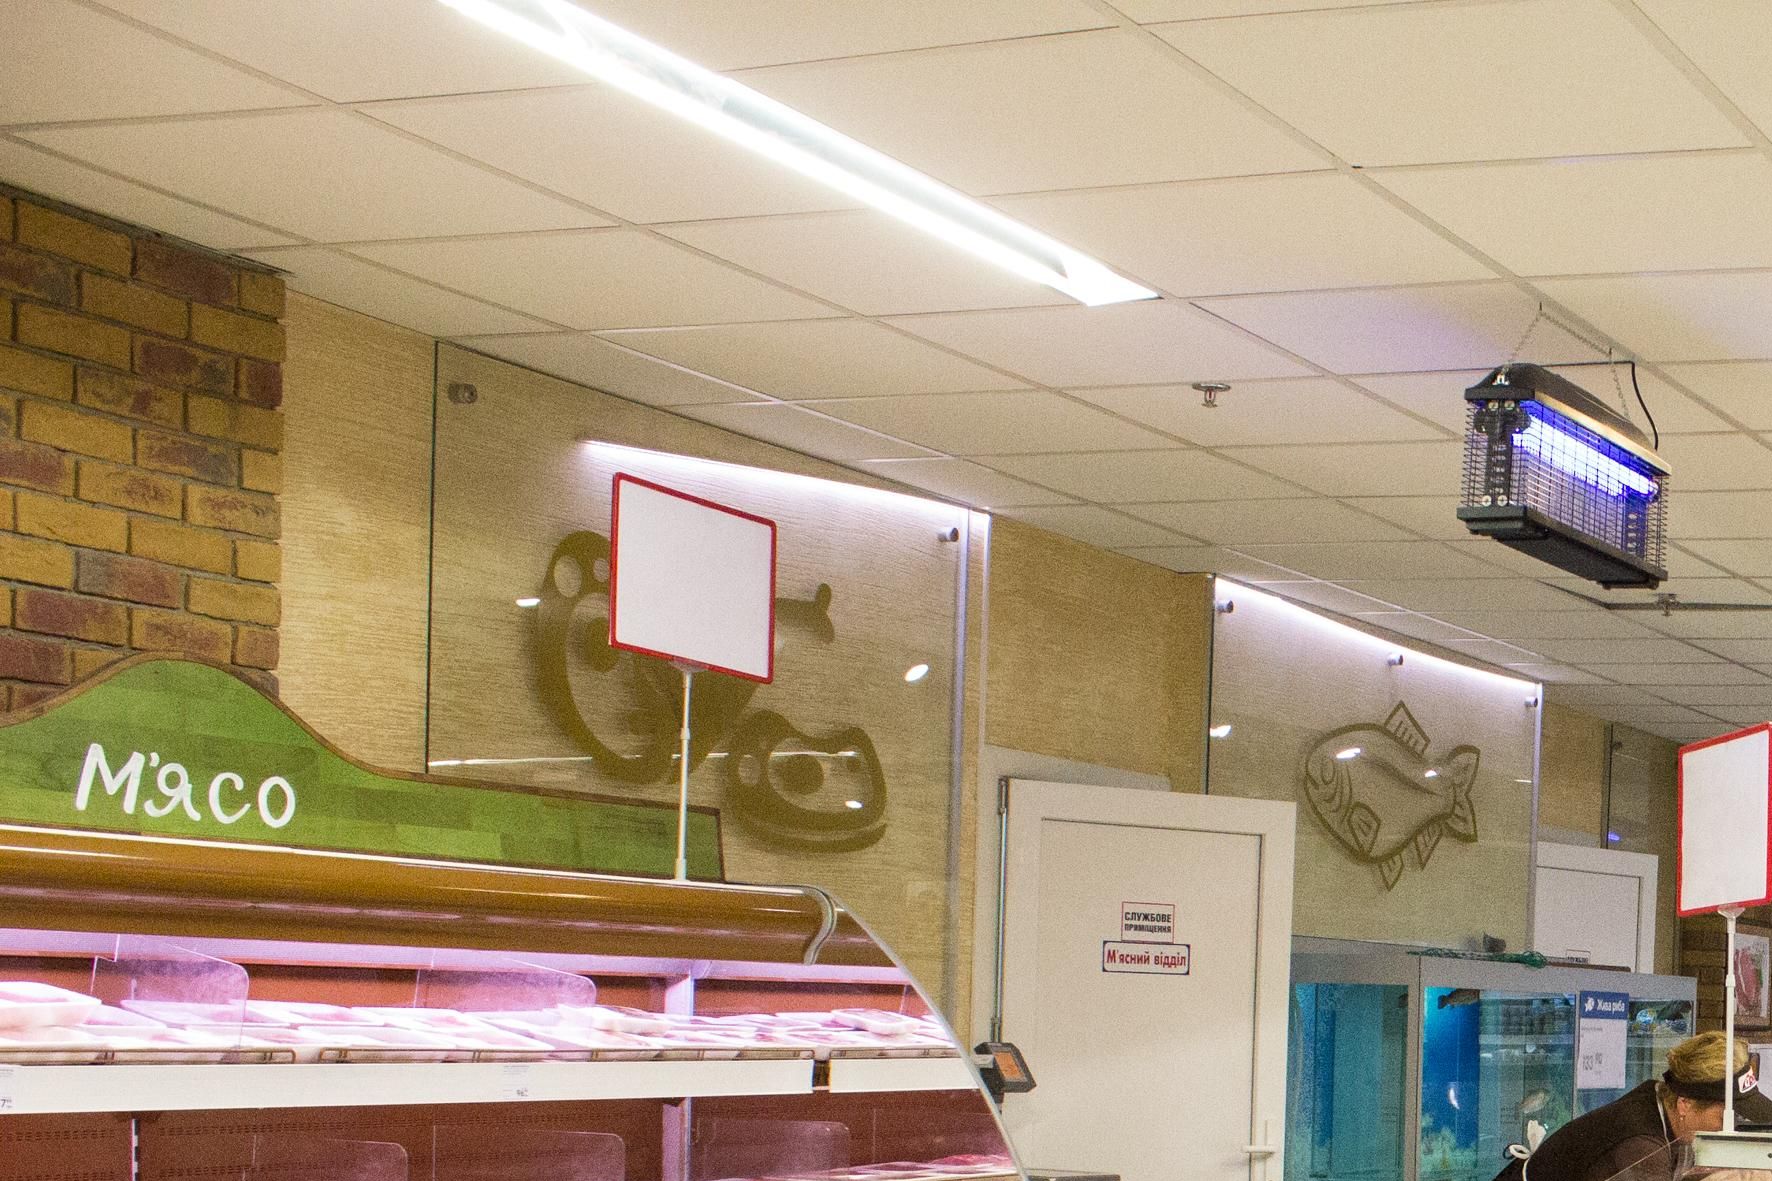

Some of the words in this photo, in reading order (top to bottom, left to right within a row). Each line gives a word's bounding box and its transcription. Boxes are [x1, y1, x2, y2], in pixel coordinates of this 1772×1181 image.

[75, 743, 297, 828] М'ясо
[1124, 911, 1172, 923] СЛУЖБОВЕ
[1106, 949, 1150, 965] М'ясний
[1153, 952, 1187, 968] відділ
